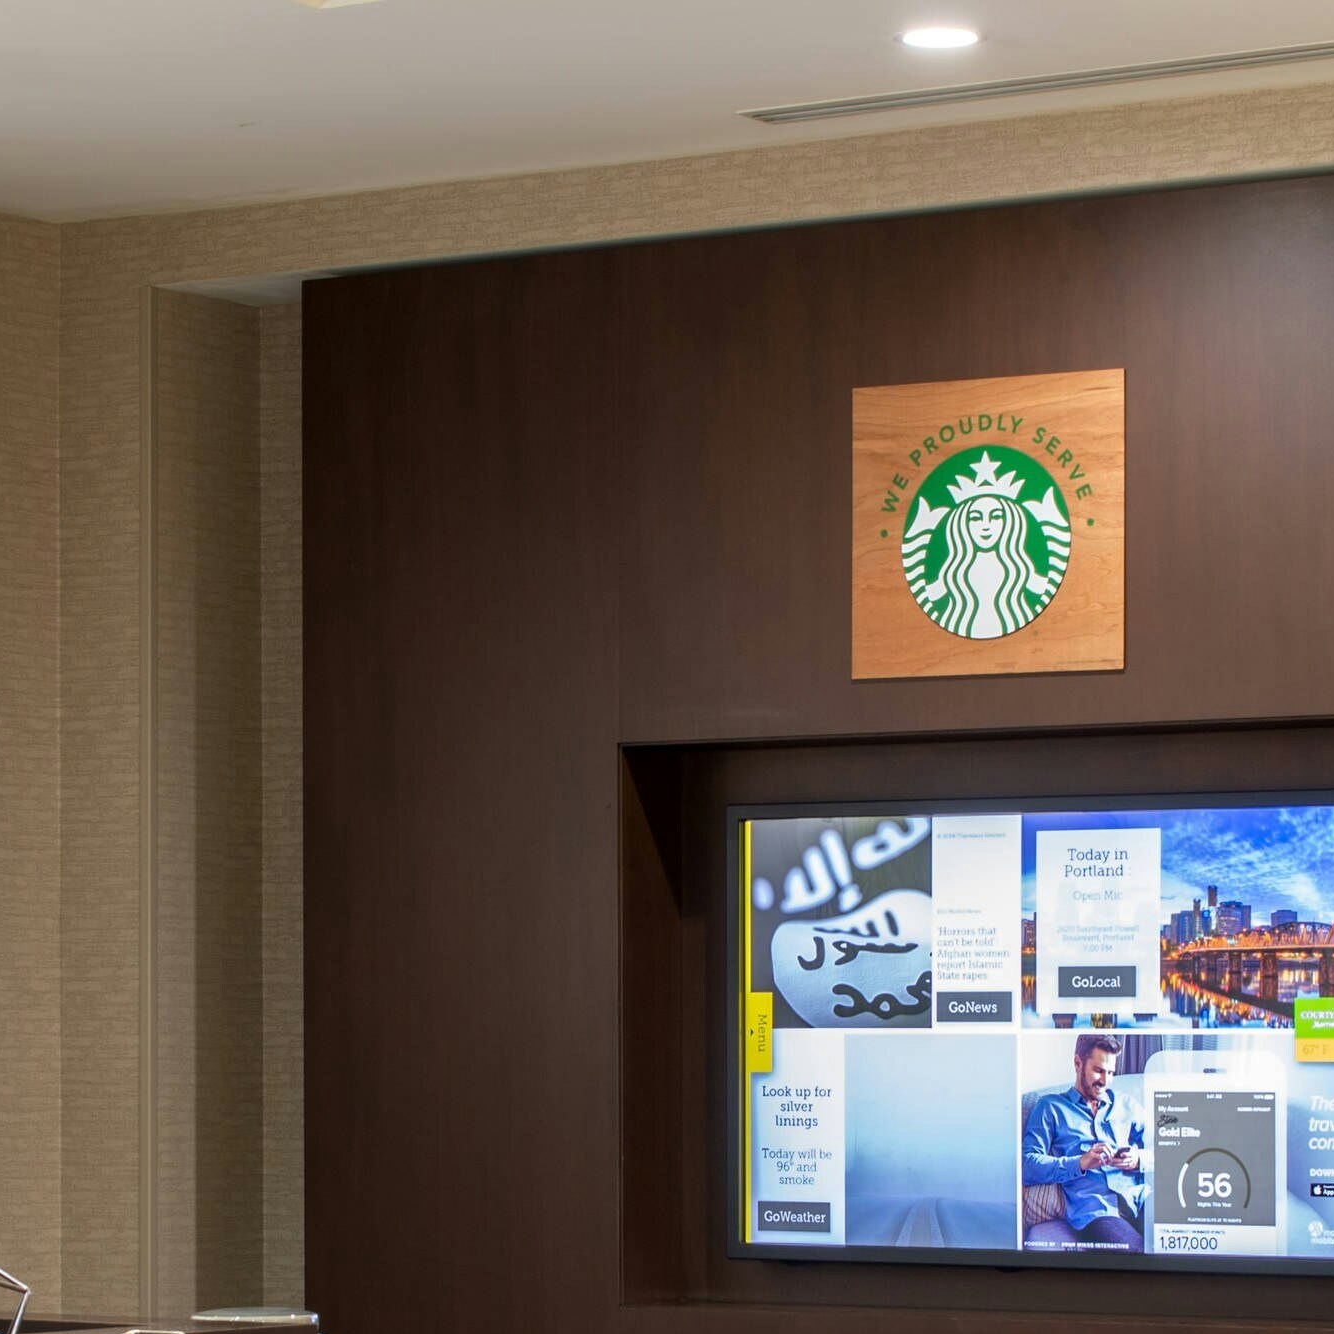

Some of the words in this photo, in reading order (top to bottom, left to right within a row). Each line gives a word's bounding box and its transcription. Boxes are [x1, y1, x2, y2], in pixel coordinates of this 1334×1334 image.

[880, 472, 910, 515] WE
[908, 413, 1024, 467] PROUDLY
[1031, 426, 1093, 501] SERVE
[1067, 848, 1110, 863] Today
[1114, 847, 1129, 861] in
[1064, 864, 1124, 878] Portland
[1072, 890, 1101, 903] Open
[1104, 889, 1123, 901] Mic
[977, 926, 997, 936] that
[961, 937, 973, 947] be
[937, 949, 972, 960] Afghan
[974, 950, 1010, 958] women
[937, 961, 966, 971] report
[968, 960, 1003, 969] Islamic
[937, 971, 961, 980] State
[962, 973, 988, 982] rapes
[1071, 975, 1121, 988] GoLocal
[948, 1001, 998, 1014] GoNews
[757, 1014, 767, 1053] Menu
[762, 1085, 791, 1097] Look
[795, 1087, 811, 1100] up
[814, 1086, 832, 1097] for
[780, 1100, 813, 1112] silver
[775, 1115, 819, 1130] linings
[1158, 1127, 1180, 1138] Gold
[1181, 1127, 1201, 1138] Elite
[762, 1148, 795, 1161] Today
[798, 1148, 816, 1160] will
[819, 1148, 832, 1160] be
[796, 1162, 817, 1172] and
[779, 1175, 815, 1185] smoke
[1197, 1172, 1232, 1198] 56
[764, 1210, 827, 1224] GoWeather
[1160, 1236, 1218, 1251] 1,817,000
